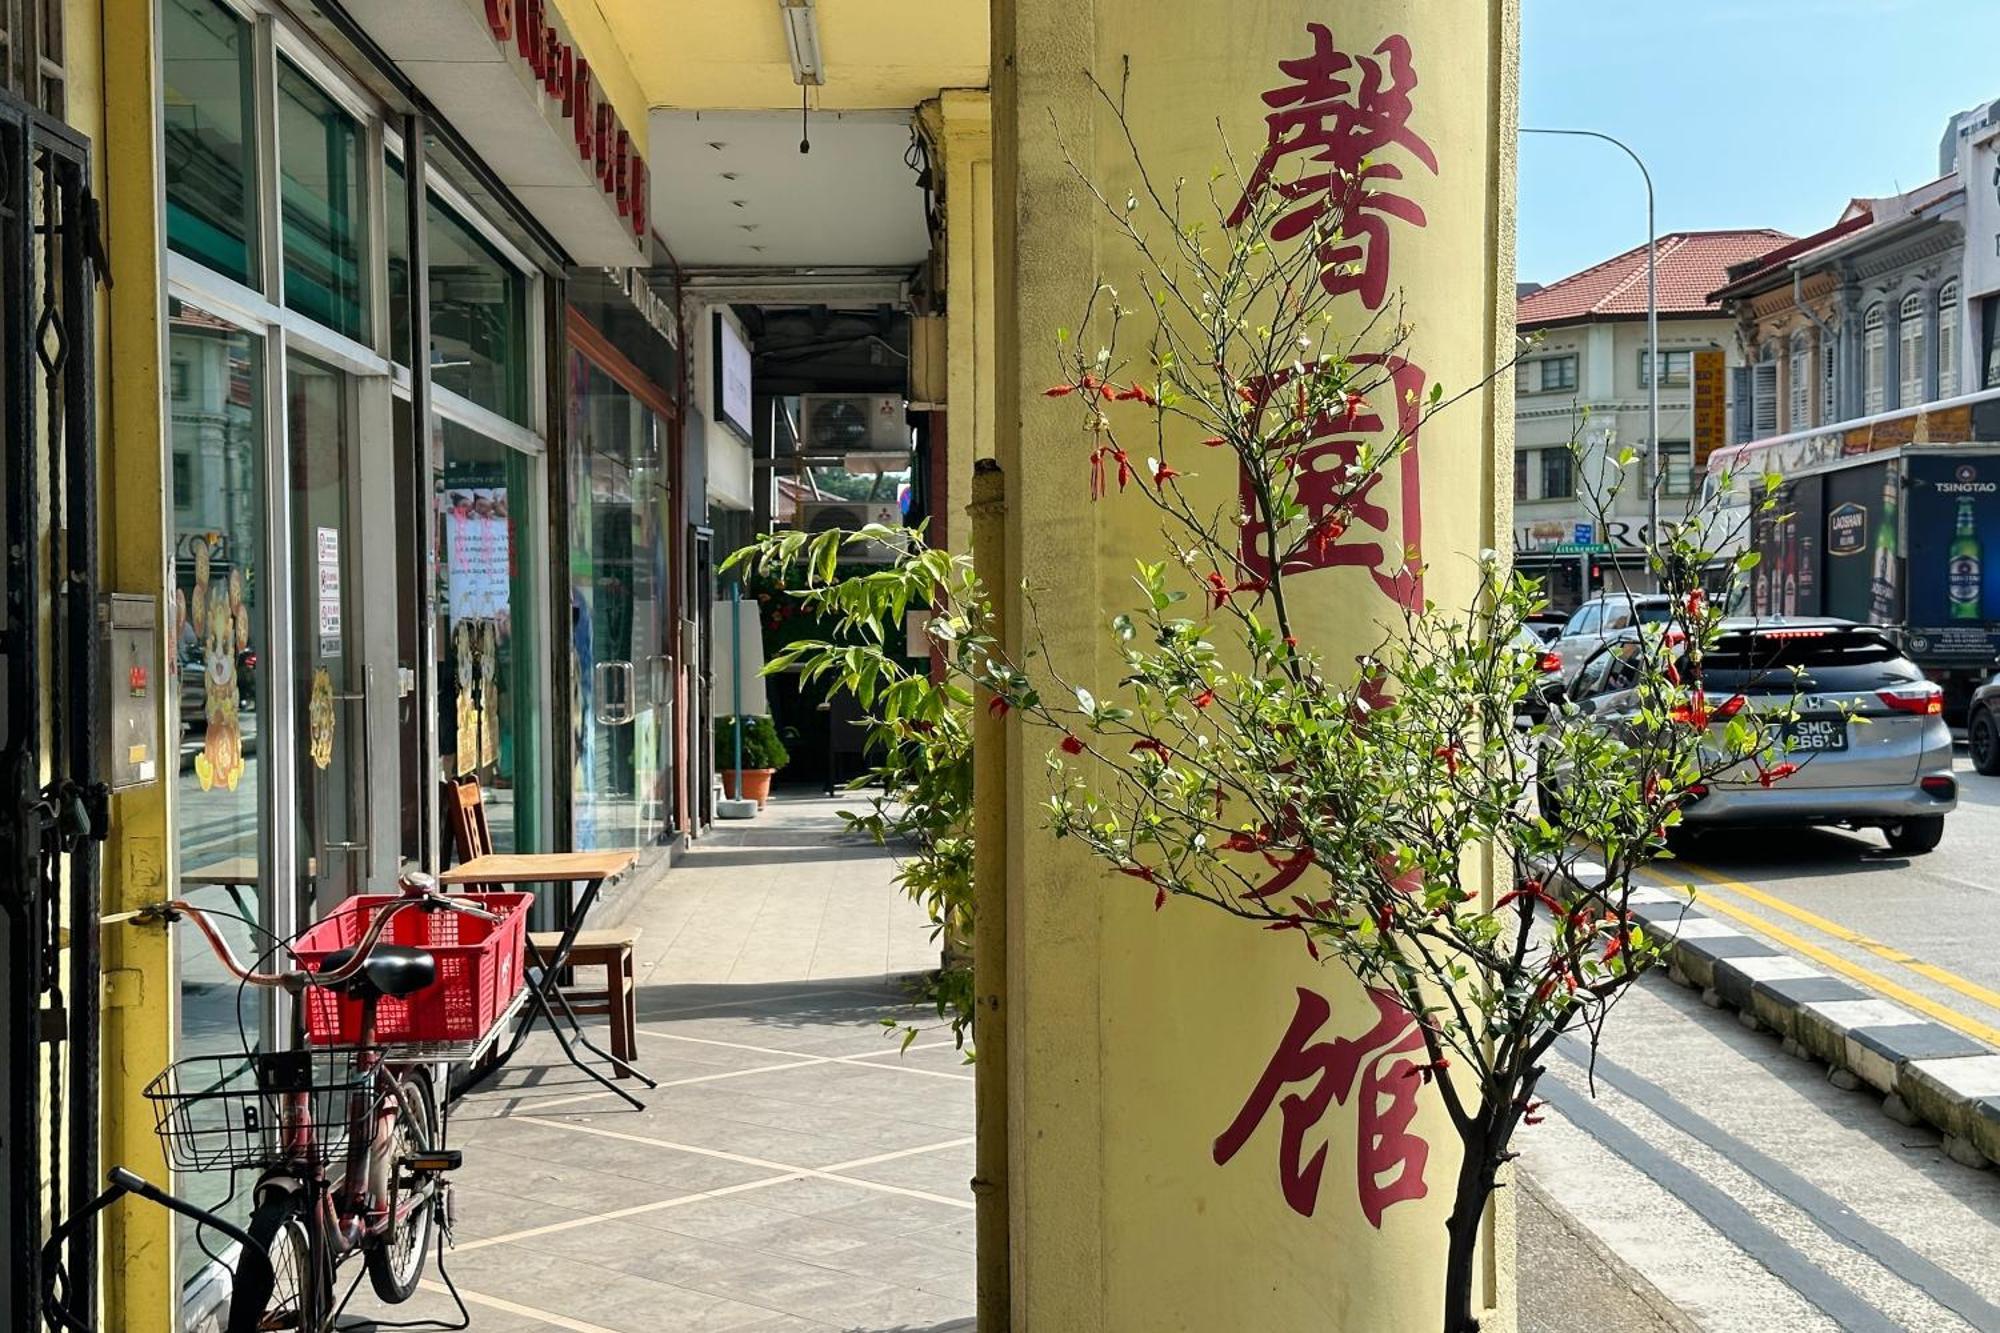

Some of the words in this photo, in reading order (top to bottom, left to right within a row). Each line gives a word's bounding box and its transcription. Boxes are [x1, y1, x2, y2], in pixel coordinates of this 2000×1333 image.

[1212, 22, 1440, 1230] 馨園馆
[1934, 482, 1997, 493] TSINGTAO
